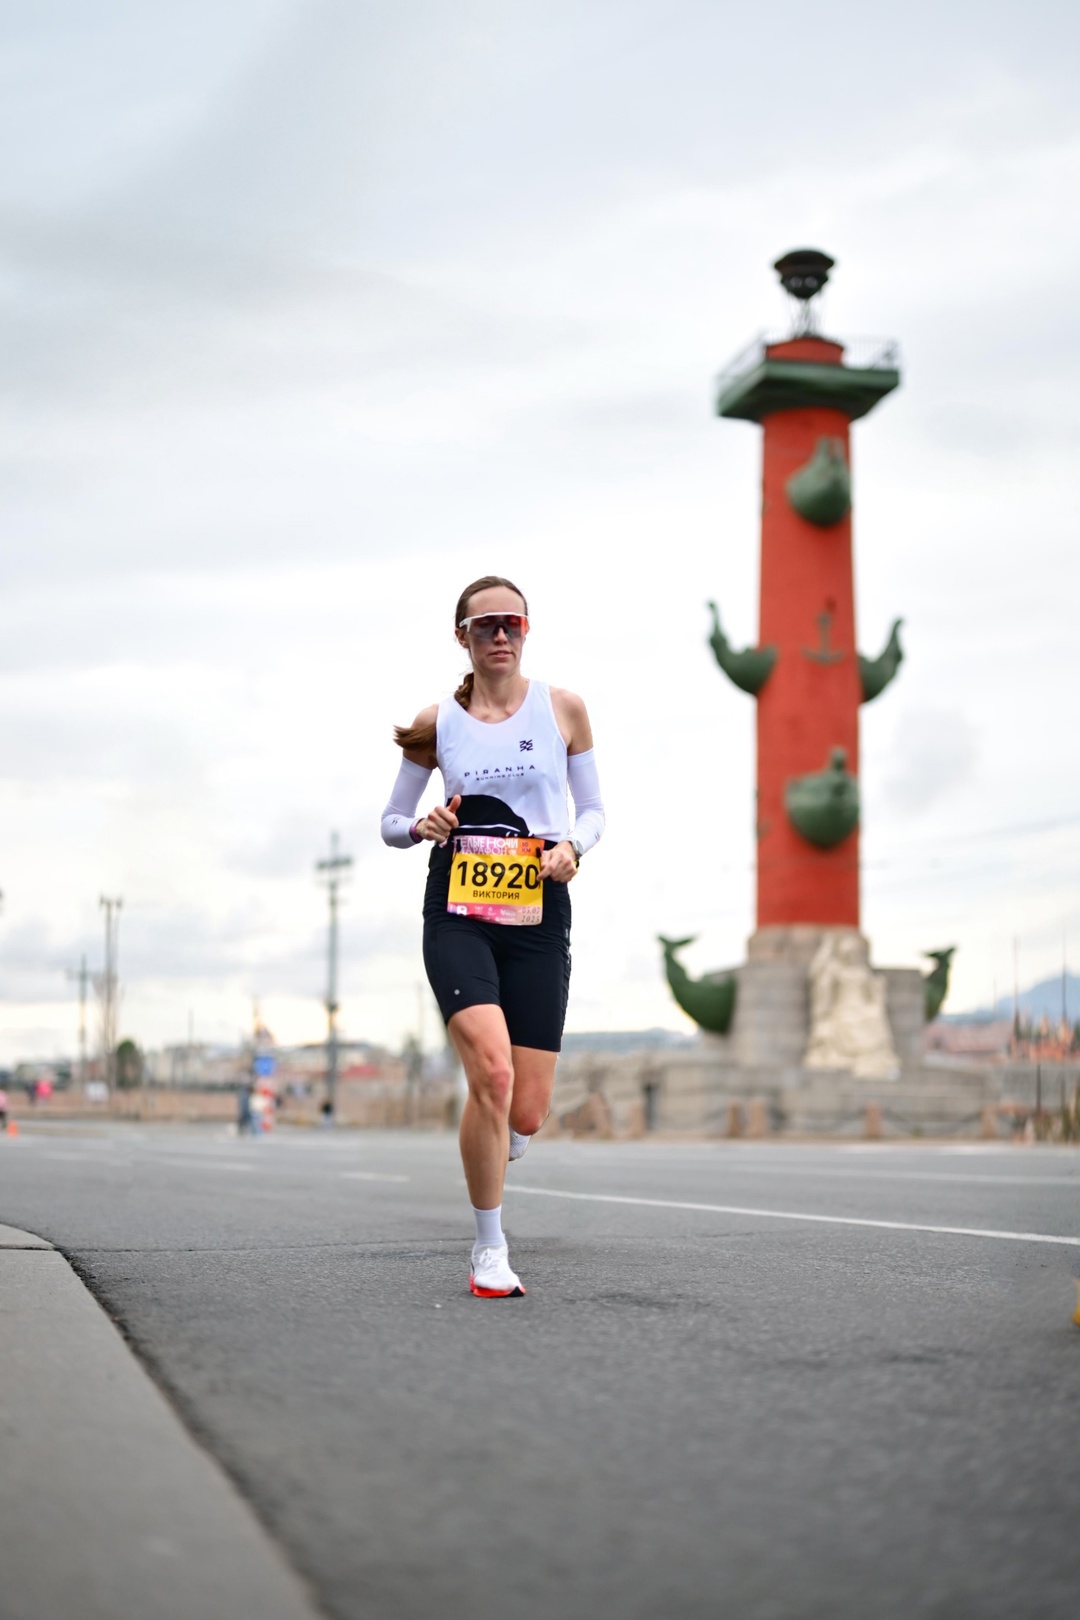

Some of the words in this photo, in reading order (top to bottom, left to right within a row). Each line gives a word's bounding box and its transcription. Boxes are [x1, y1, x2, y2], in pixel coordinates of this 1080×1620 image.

[464, 765, 535, 777] PIRANHA
[486, 837, 518, 849] НОЧИ
[457, 861, 540, 890] 18920
[473, 890, 520, 900] ВИКТОРИЯ
